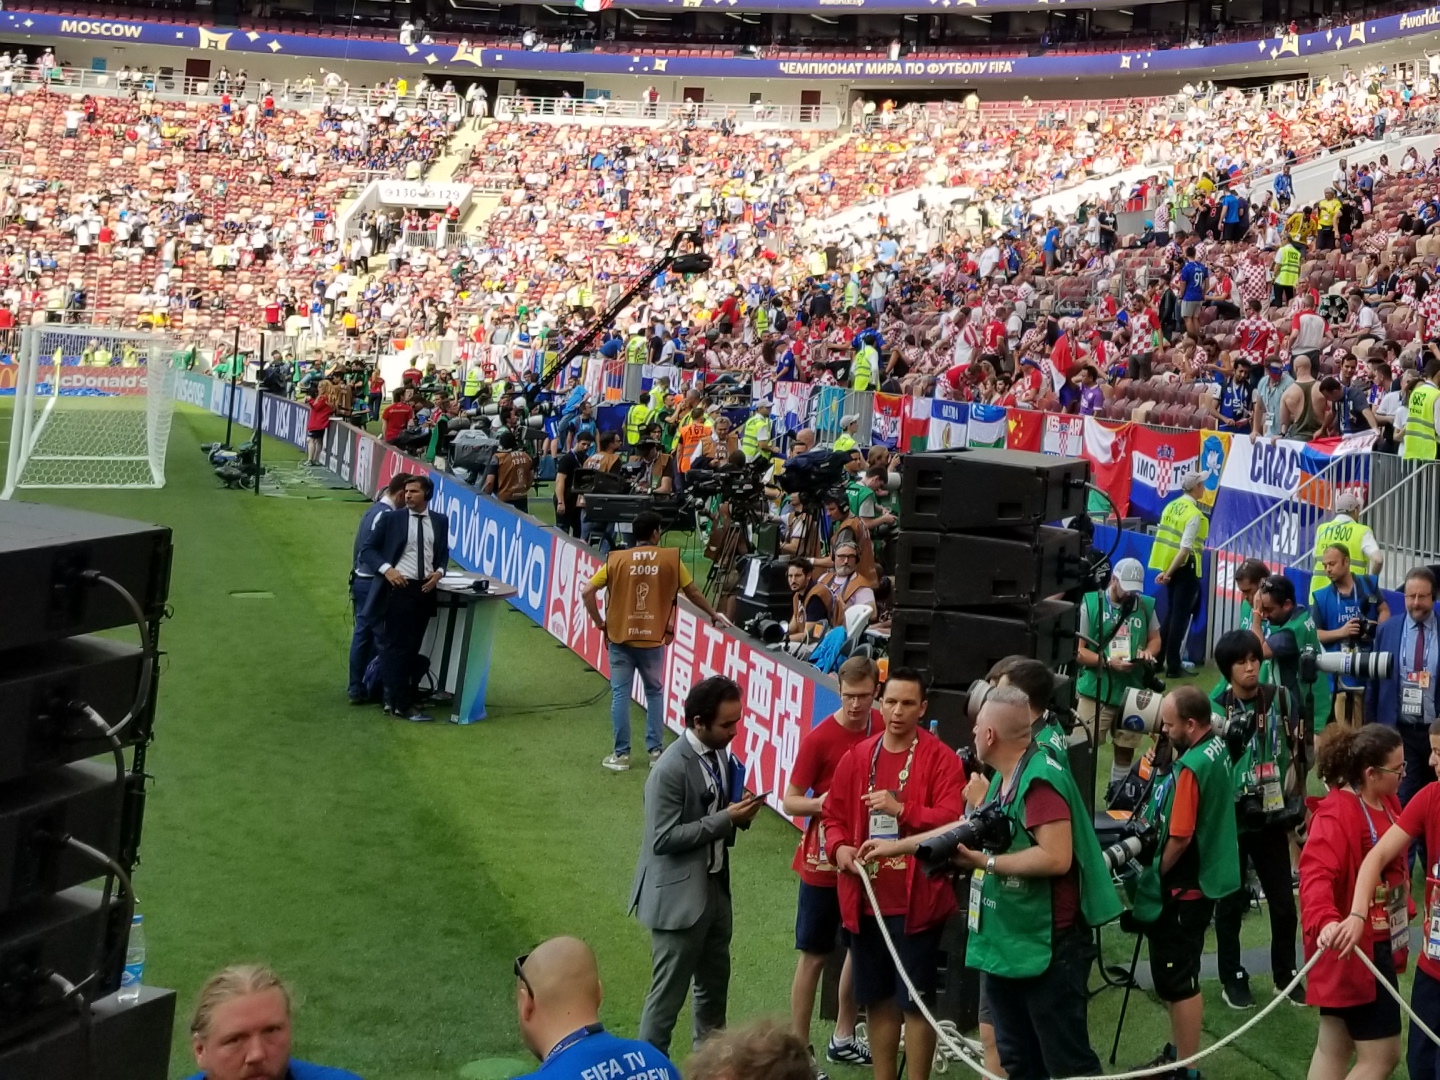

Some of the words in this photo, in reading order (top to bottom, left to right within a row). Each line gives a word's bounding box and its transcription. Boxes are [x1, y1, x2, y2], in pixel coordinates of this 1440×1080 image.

[61, 19, 142, 38] MOSCOW
[780, 62, 863, 75] ЧЕМПИОНАТ
[865, 62, 902, 75] МИРА
[905, 62, 923, 74] ПО
[926, 61, 987, 74] ФУТБОЛУ
[1246, 331, 1257, 349] 7
[462, 495, 498, 577] vivo
[501, 518, 545, 610] vivo
[632, 551, 657, 561] RTV
[630, 565, 659, 576] 2009
[581, 1058, 625, 1080] FIFA
[622, 1051, 647, 1072] TV
